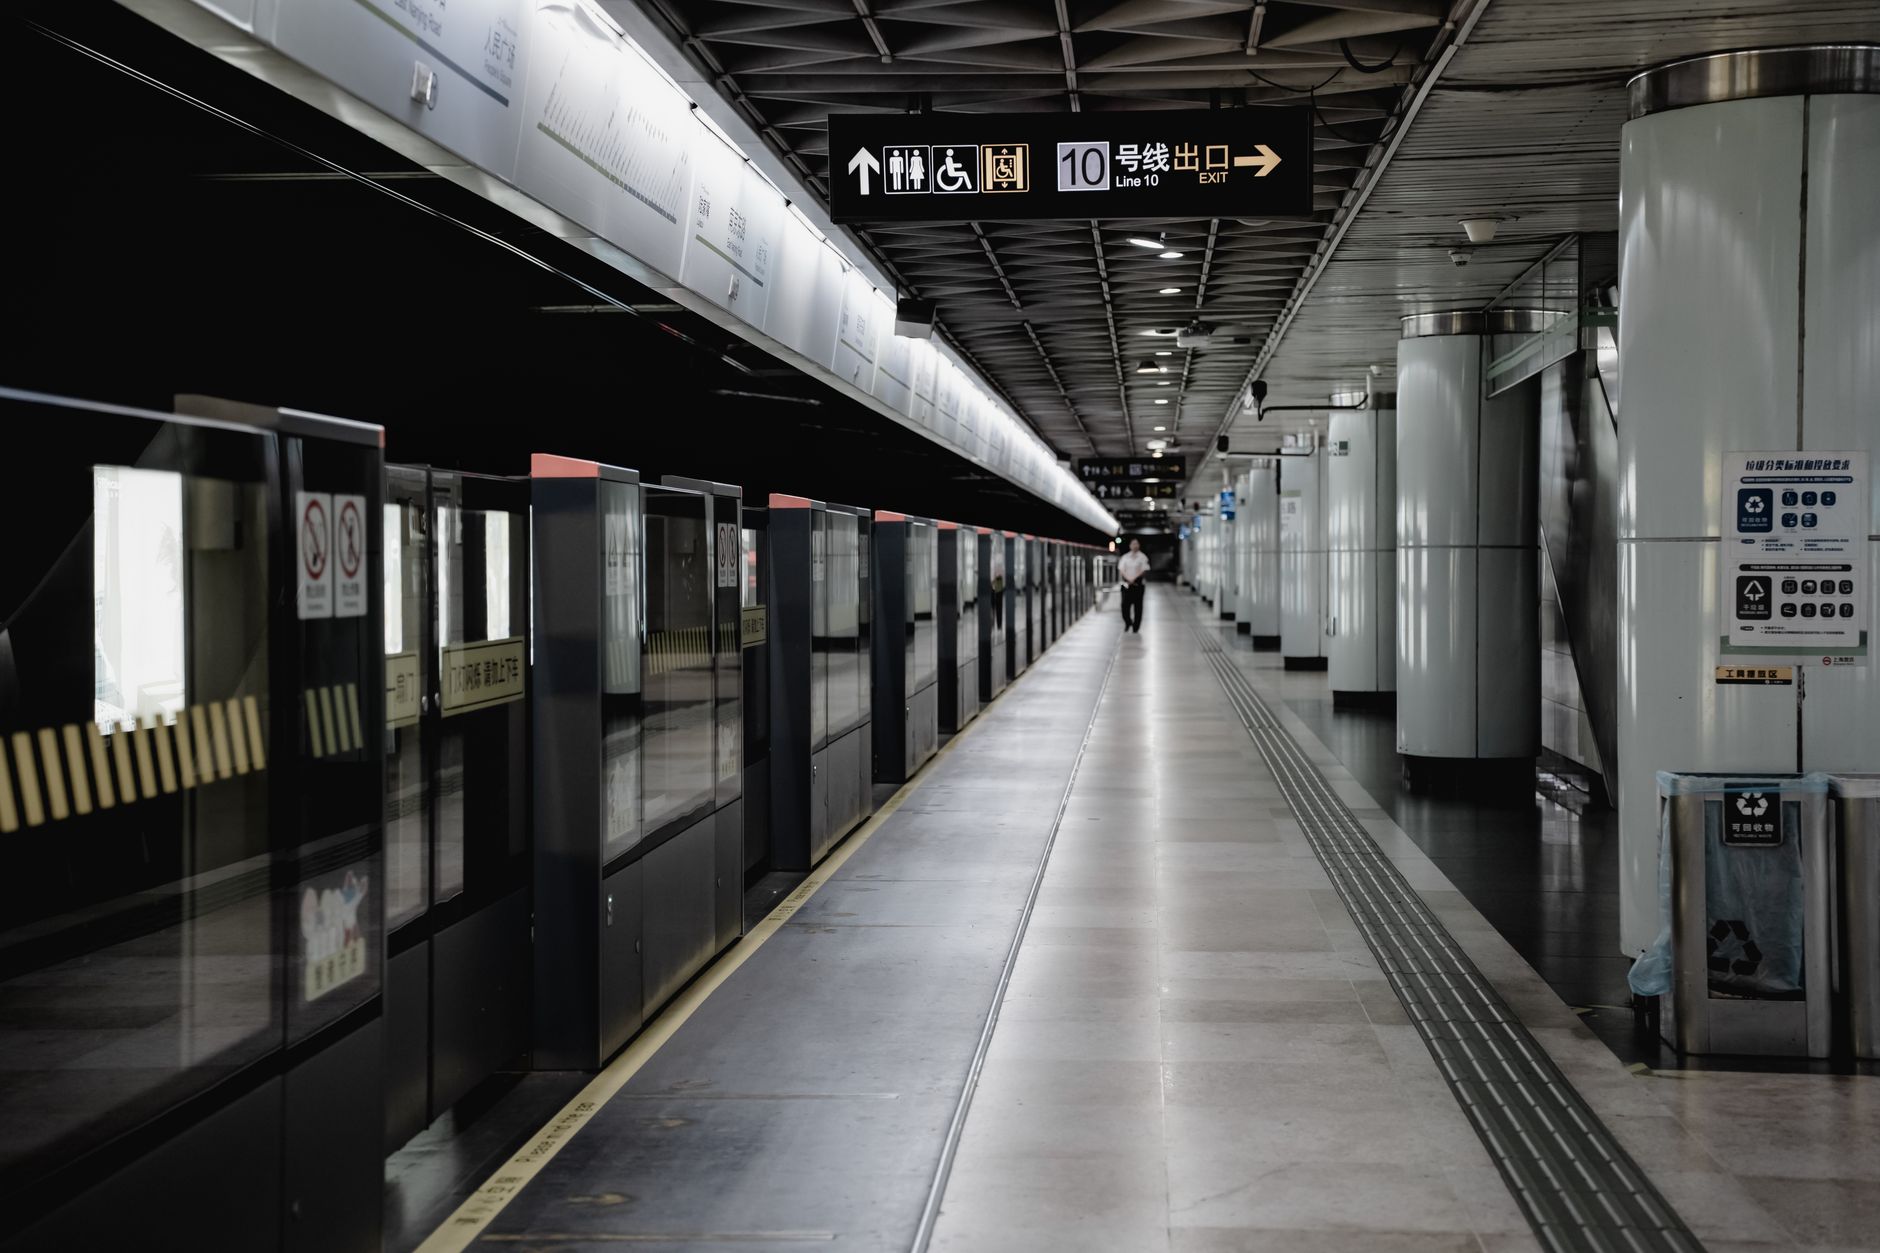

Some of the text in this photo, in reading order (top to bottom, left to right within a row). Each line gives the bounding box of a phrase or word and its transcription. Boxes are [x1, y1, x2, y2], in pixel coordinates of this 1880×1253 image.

[1062, 142, 1170, 186] 10 号线
[1174, 142, 1230, 172] 出口
[1116, 174, 1159, 188] Line 10
[1199, 172, 1229, 184] EXIT
[1731, 823, 1774, 832] 可回收物
